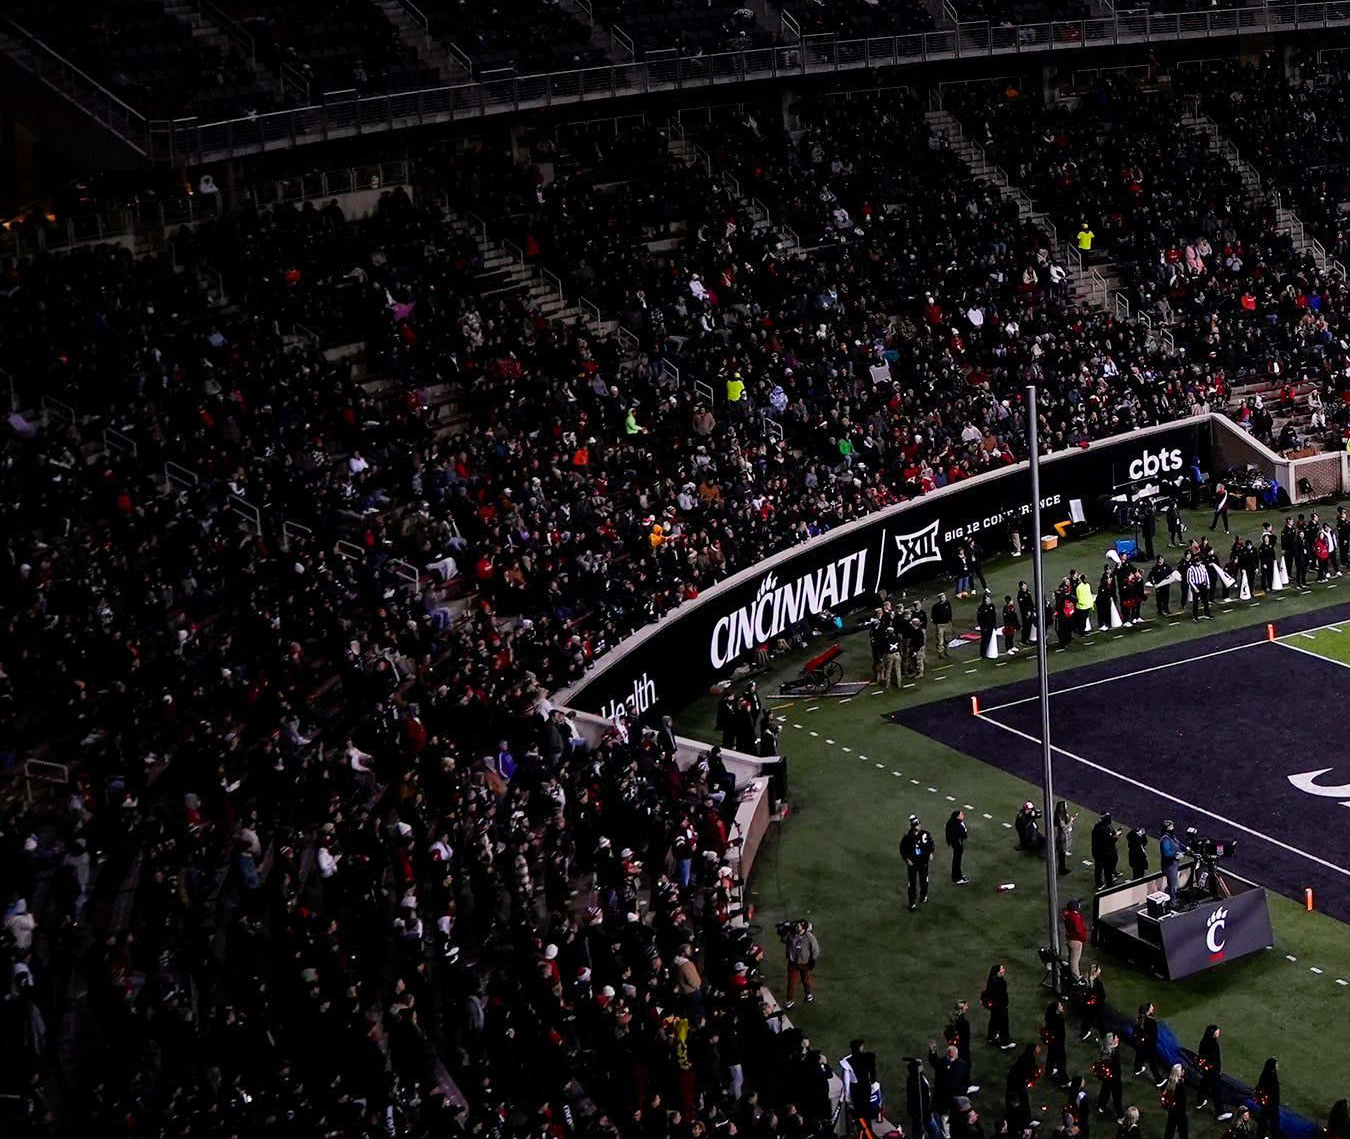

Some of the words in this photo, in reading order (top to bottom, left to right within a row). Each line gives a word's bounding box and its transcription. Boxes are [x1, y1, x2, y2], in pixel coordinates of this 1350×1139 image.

[1129, 447, 1183, 480] cbts
[944, 524, 964, 542] BIG
[966, 520, 980, 535] 12
[710, 548, 868, 670] CINCINNATI
